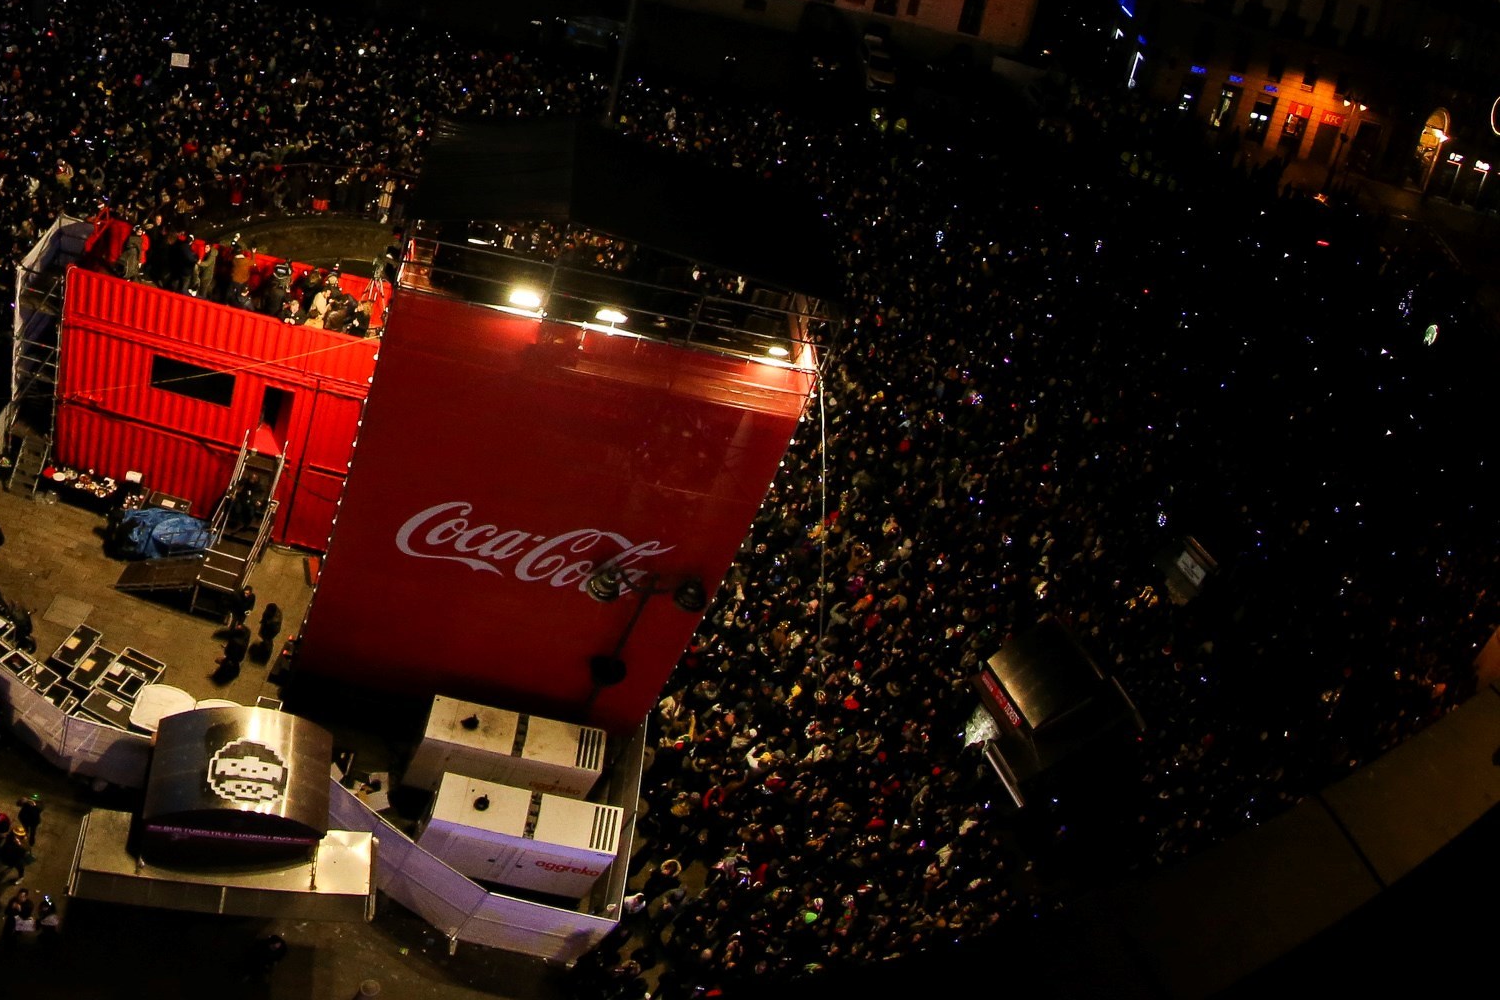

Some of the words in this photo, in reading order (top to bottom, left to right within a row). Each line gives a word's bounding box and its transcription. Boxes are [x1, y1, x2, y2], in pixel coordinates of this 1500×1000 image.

[1323, 112, 1341, 126] KFC
[396, 501, 677, 597] Coca-Cola
[528, 780, 582, 796] aggreko
[535, 859, 601, 877] aggreko
